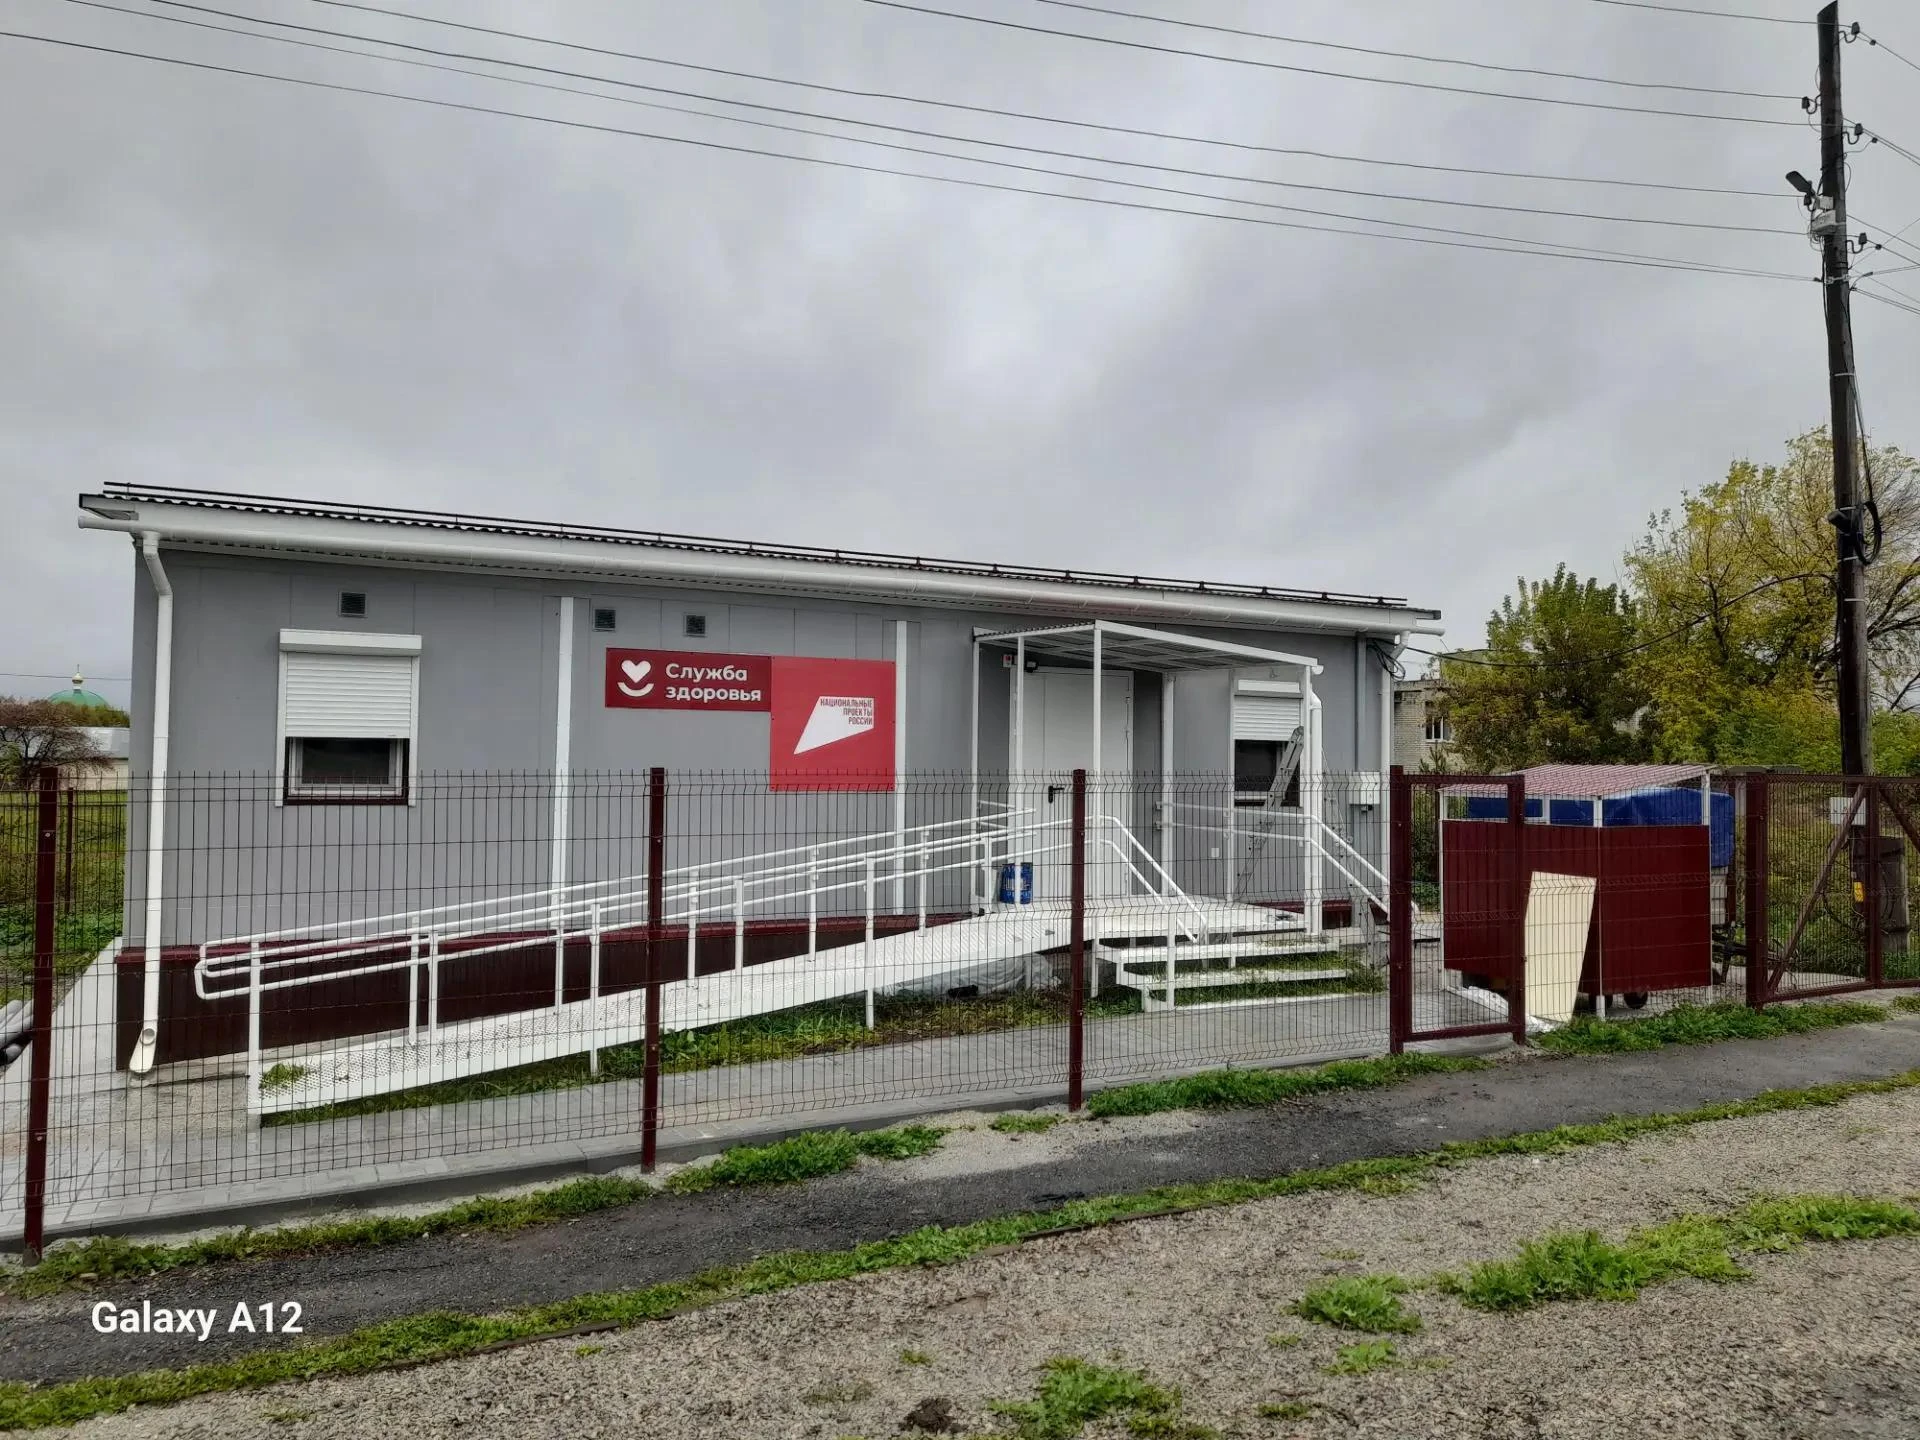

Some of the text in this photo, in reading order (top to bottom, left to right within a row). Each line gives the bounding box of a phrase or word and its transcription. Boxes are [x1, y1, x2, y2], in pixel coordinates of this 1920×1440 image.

[665, 662, 748, 683] Служба
[665, 686, 761, 703] здоровья
[820, 698, 873, 708] НАЦИОНАЛЬНЫЕ
[843, 707, 873, 717] ПРОЕКТЫ
[848, 716, 873, 725] РОССИИ
